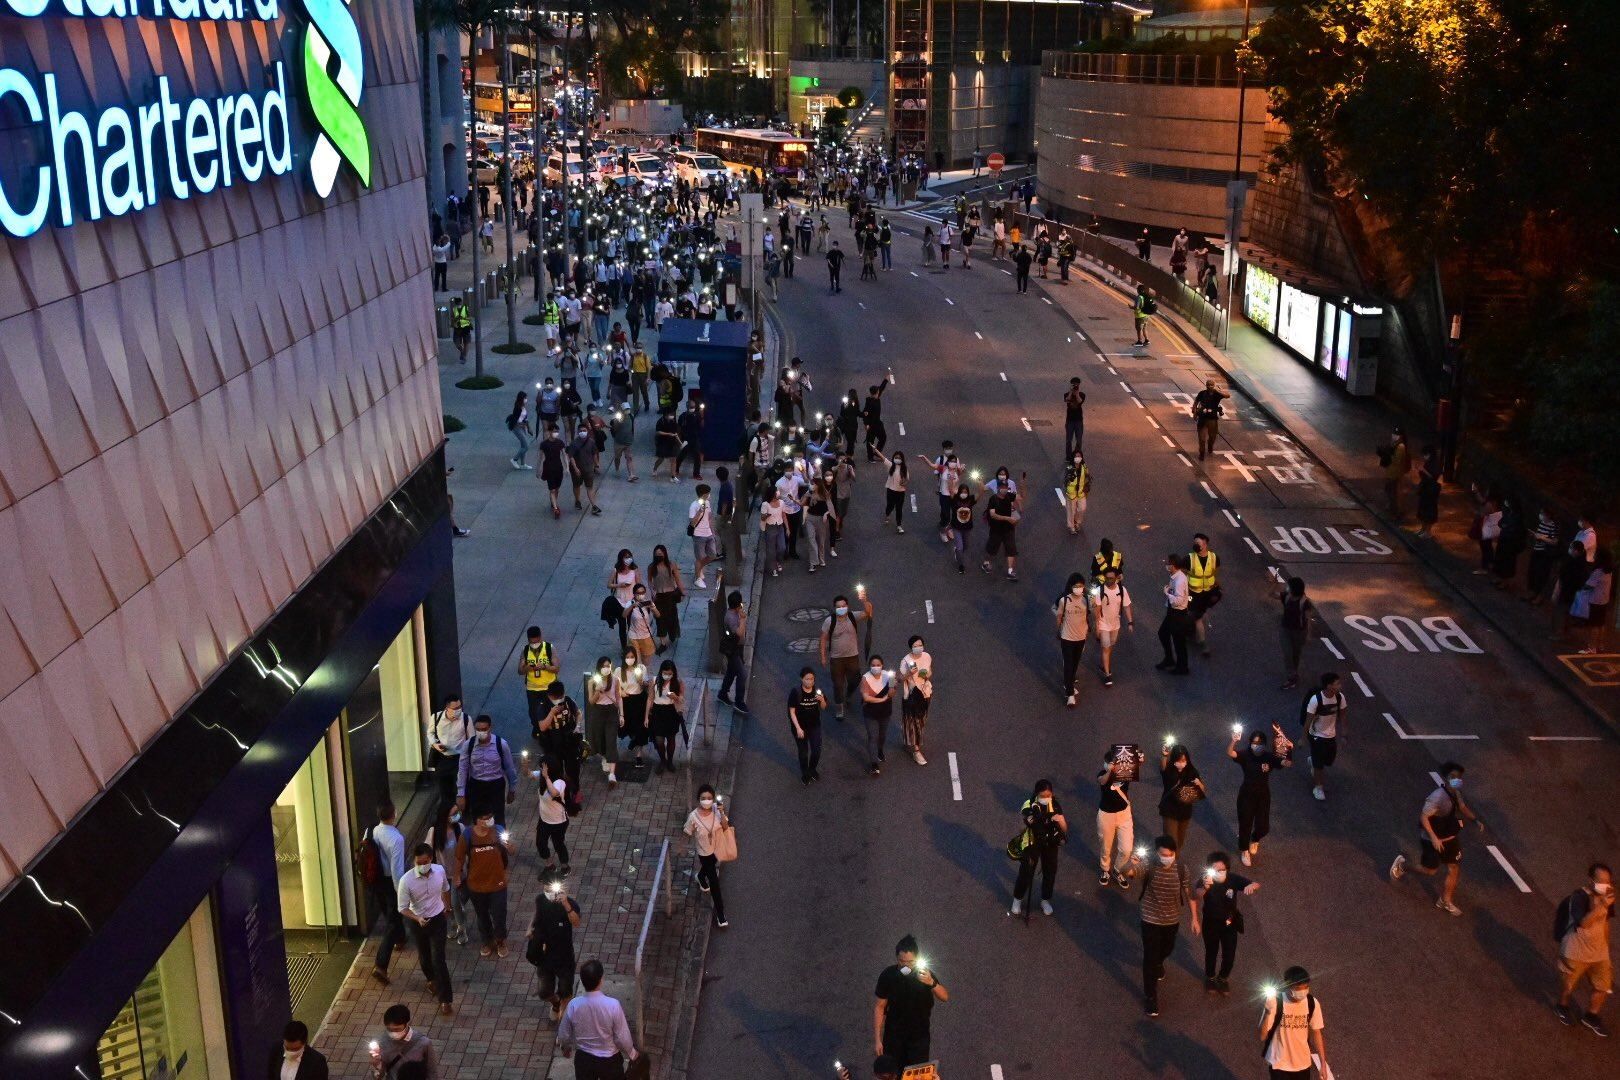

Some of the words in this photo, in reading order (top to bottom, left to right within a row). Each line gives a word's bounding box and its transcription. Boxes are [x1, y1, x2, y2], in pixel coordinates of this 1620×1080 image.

[0, 61, 292, 237] Chartered
[1269, 526, 1393, 555] STOP
[1343, 614, 1484, 654] BUS
